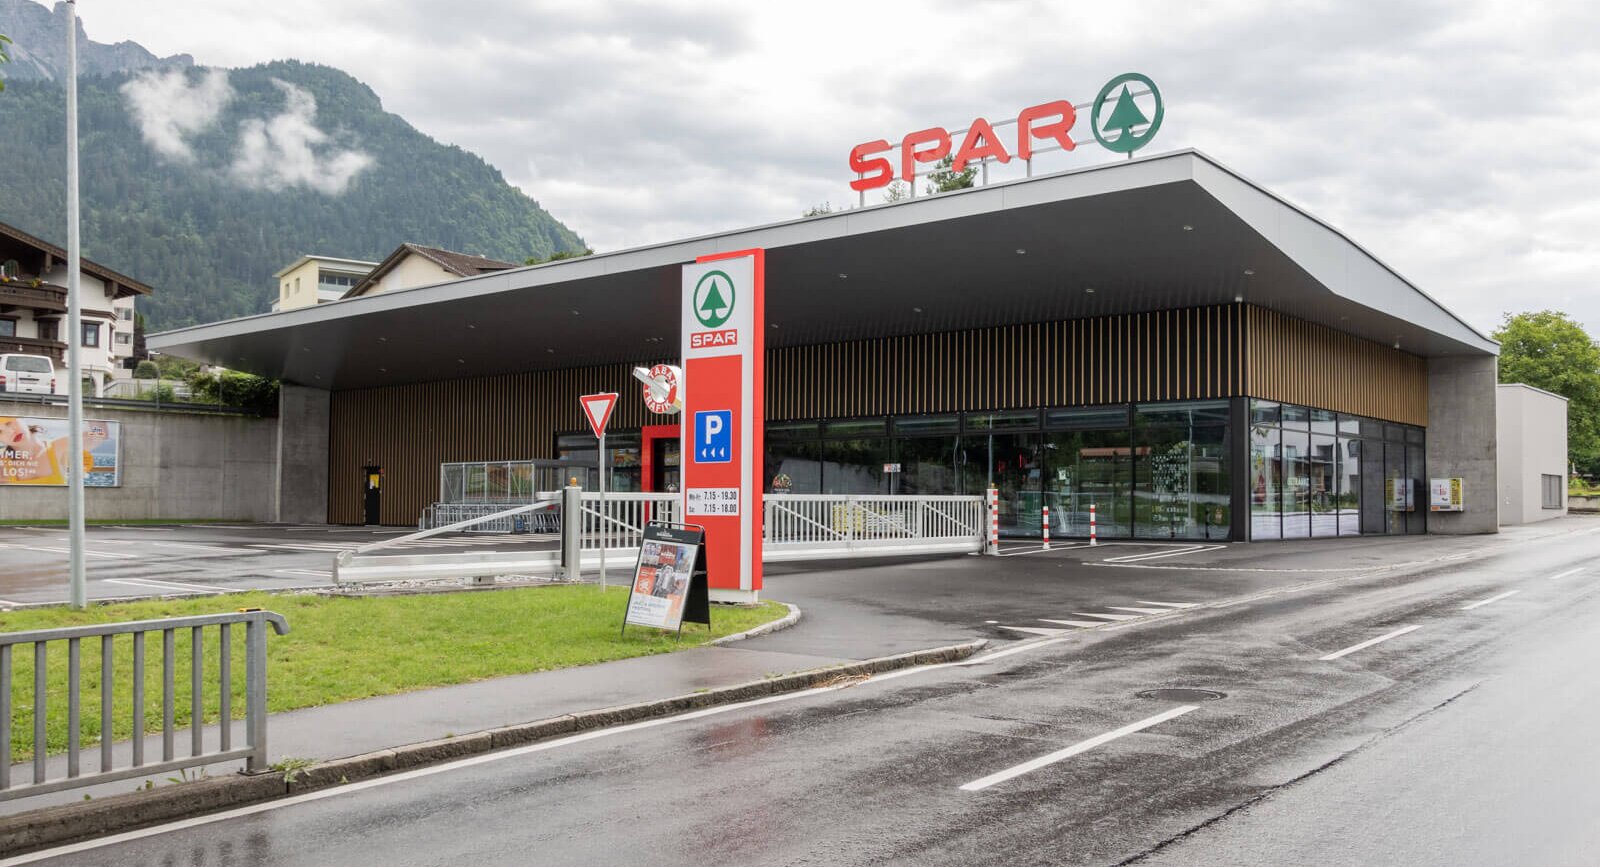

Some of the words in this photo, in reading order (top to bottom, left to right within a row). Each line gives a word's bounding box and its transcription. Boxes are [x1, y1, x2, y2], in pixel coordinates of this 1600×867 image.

[850, 100, 1077, 192] SPAR
[692, 331, 736, 347] SPAR
[705, 415, 723, 445] P
[704, 491, 716, 500] 7.15
[721, 491, 737, 500] 19.30
[704, 503, 716, 512] 7.15
[721, 503, 737, 512] 18.00
